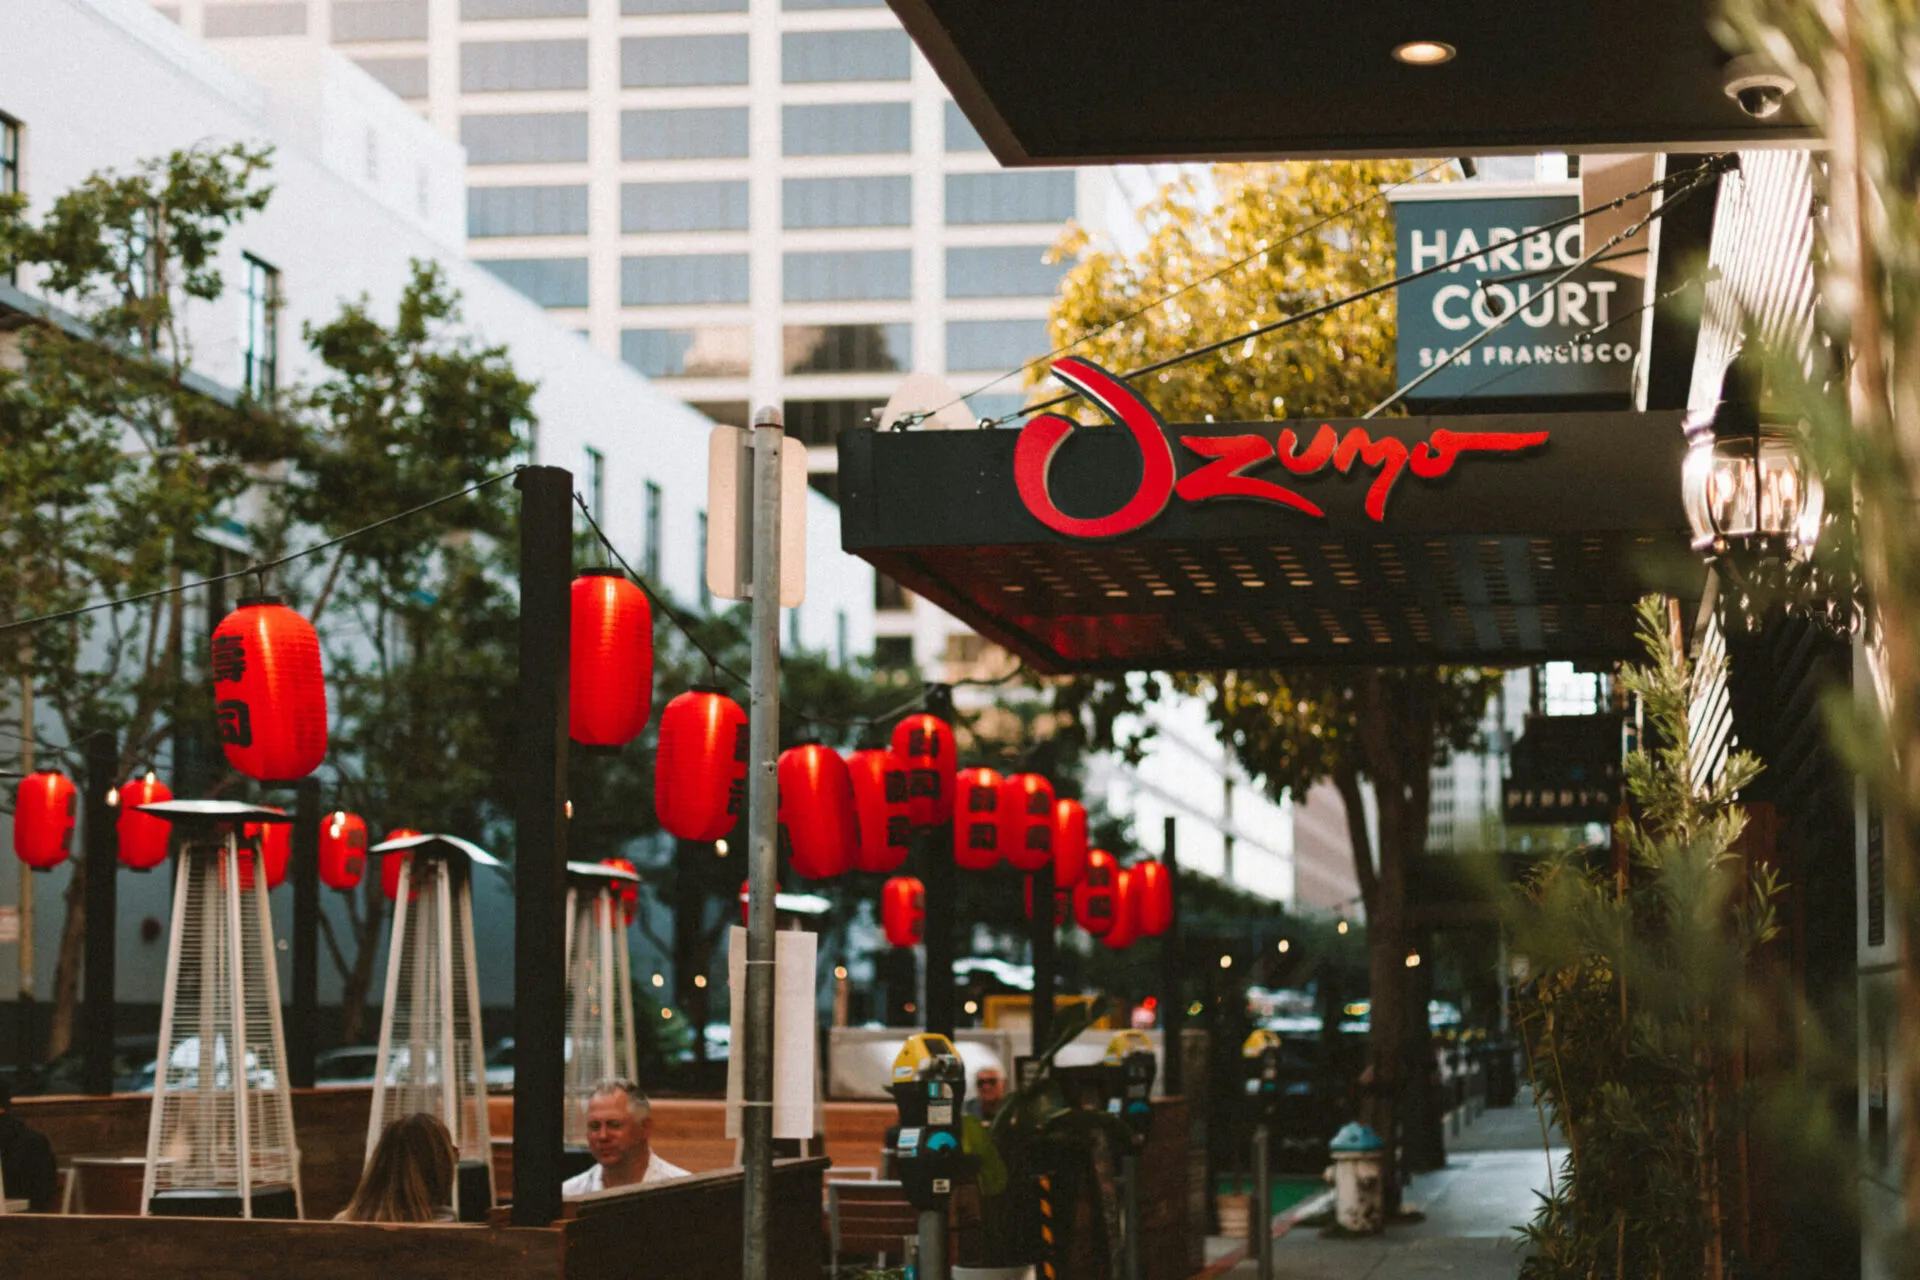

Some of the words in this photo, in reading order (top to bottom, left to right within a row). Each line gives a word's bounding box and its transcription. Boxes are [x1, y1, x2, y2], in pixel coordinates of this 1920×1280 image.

[1432, 281, 1616, 331] COURT
[1418, 346, 1472, 368] SAN
[1483, 342, 1633, 366] FRANCISCO
